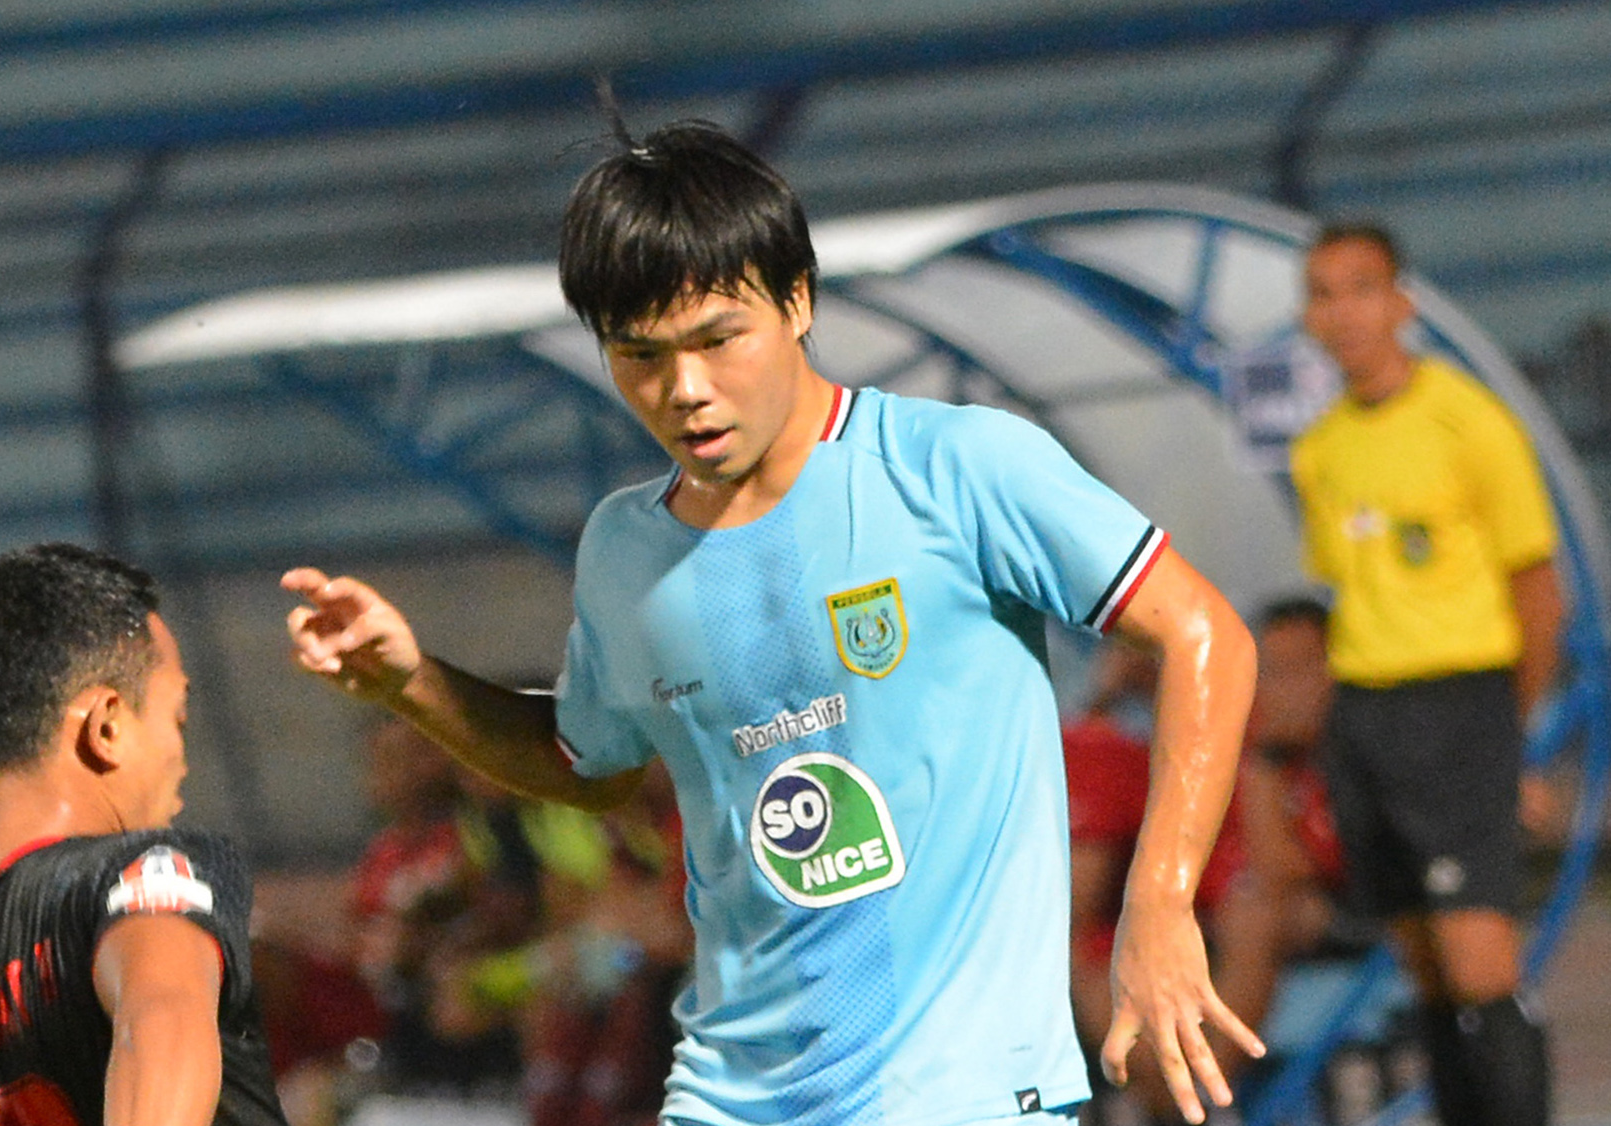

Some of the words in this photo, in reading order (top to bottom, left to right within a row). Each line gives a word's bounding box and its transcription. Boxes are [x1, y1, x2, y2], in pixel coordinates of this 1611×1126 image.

[733, 693, 846, 757] Northcliff
[762, 790, 825, 840] SO
[800, 837, 889, 891] NICE
